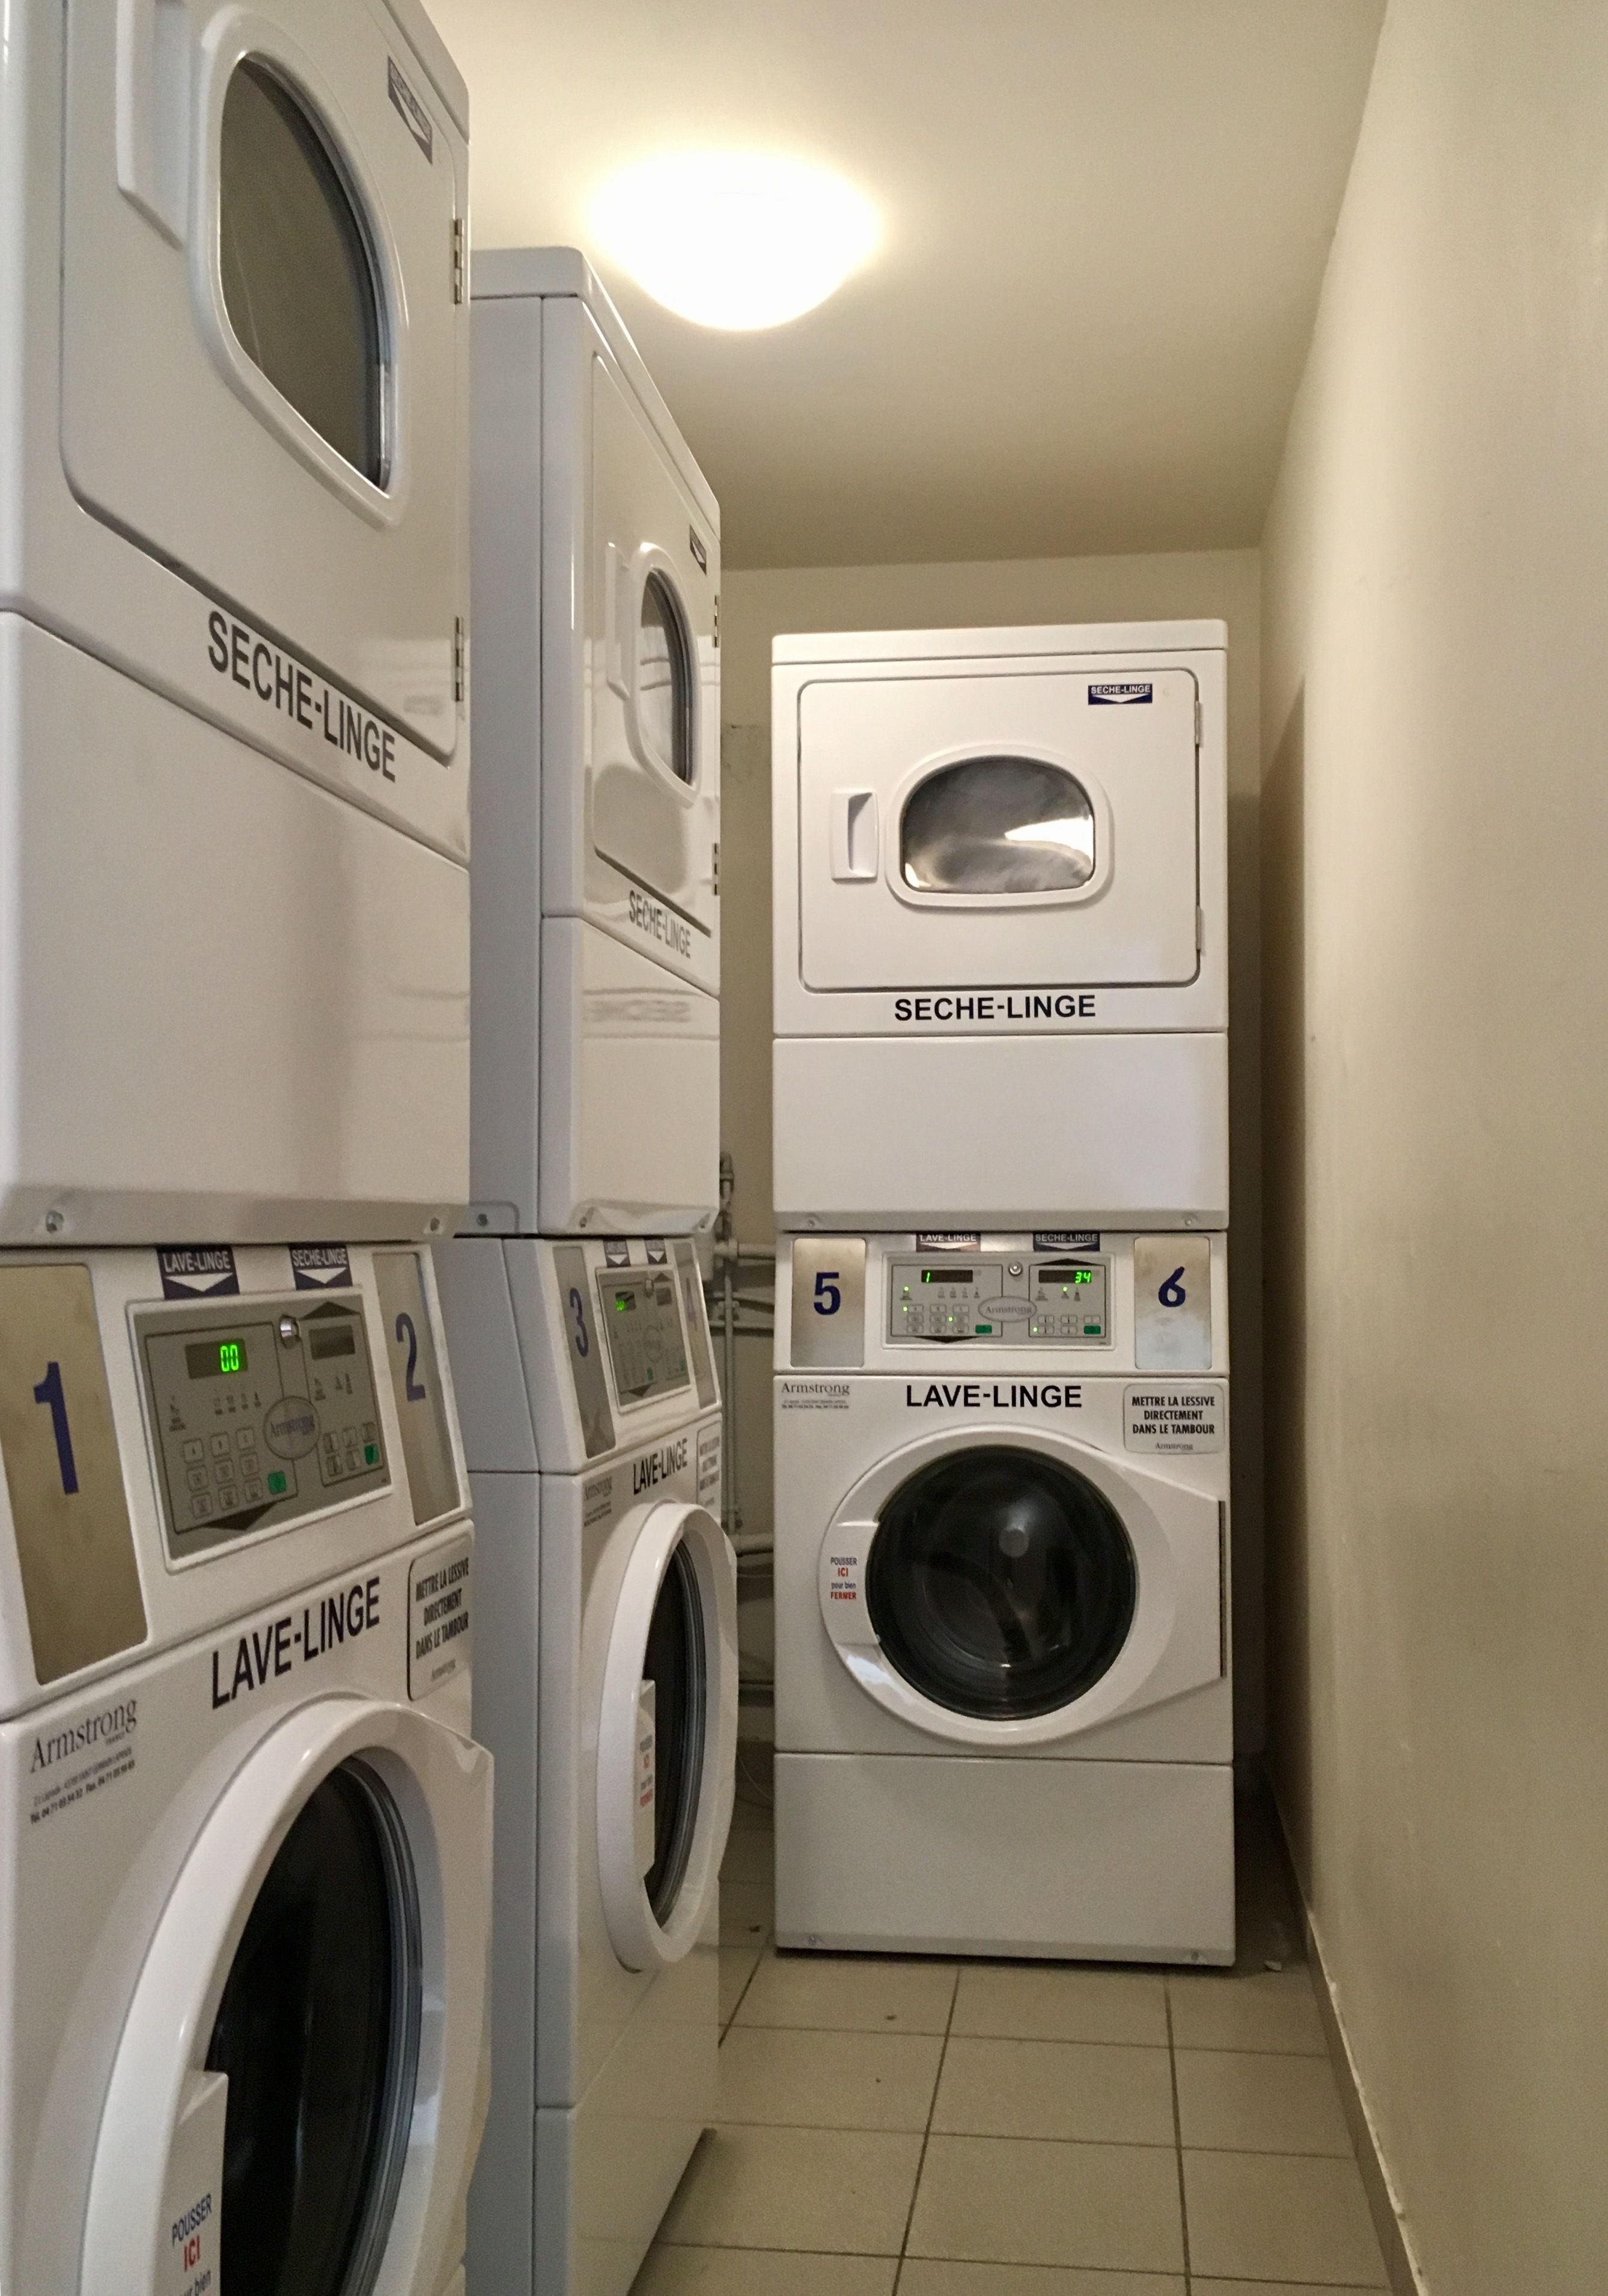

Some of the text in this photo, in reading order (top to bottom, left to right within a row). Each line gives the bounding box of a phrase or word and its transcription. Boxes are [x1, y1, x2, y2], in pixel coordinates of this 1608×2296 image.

[208, 611, 395, 783] SECHE-LINGE
[1091, 685, 1150, 694] SECHE-LINGE
[629, 890, 691, 959] SECHE-LINGE
[895, 994, 1097, 1021] SECHE-LINGE
[920, 1233, 976, 1242] LAVE-LINGE
[1035, 1233, 1098, 1242] SECHE-LINGE
[163, 1250, 231, 1273] LAVE-LINGE
[291, 1248, 347, 1267] SECHE-LINGE
[1074, 1271, 1091, 1284] 34
[1158, 1265, 1187, 1308] 6
[813, 1272, 841, 1315] 5
[569, 1287, 589, 1357] 3
[220, 1344, 239, 1372] 00
[396, 1312, 427, 1403] 2
[781, 1383, 850, 1396] Armstrong
[906, 1384, 1083, 1408] LAVE-LINGE
[1131, 1396, 1215, 1406] METTRE LA LESSIVE
[33, 1362, 79, 1495] 1
[1133, 1424, 1215, 1434] DANS LE TAMBOUR
[1144, 1410, 1204, 1421] DIRECTEMENT
[633, 1437, 687, 1495] LAVE-LINGE
[830, 1557, 857, 1566] POUSSER
[838, 1567, 849, 1577] ICI
[416, 1557, 469, 1602] METTRE LA LESSIVE
[424, 1587, 462, 1626] DIRECTEMENT
[212, 1576, 380, 1709] LAVE-LINGE
[416, 1632, 433, 1660] DANS
[31, 1699, 138, 1773] Armstrong
[172, 2192, 212, 2247] POUSSER
[183, 2235, 201, 2273] ICI
